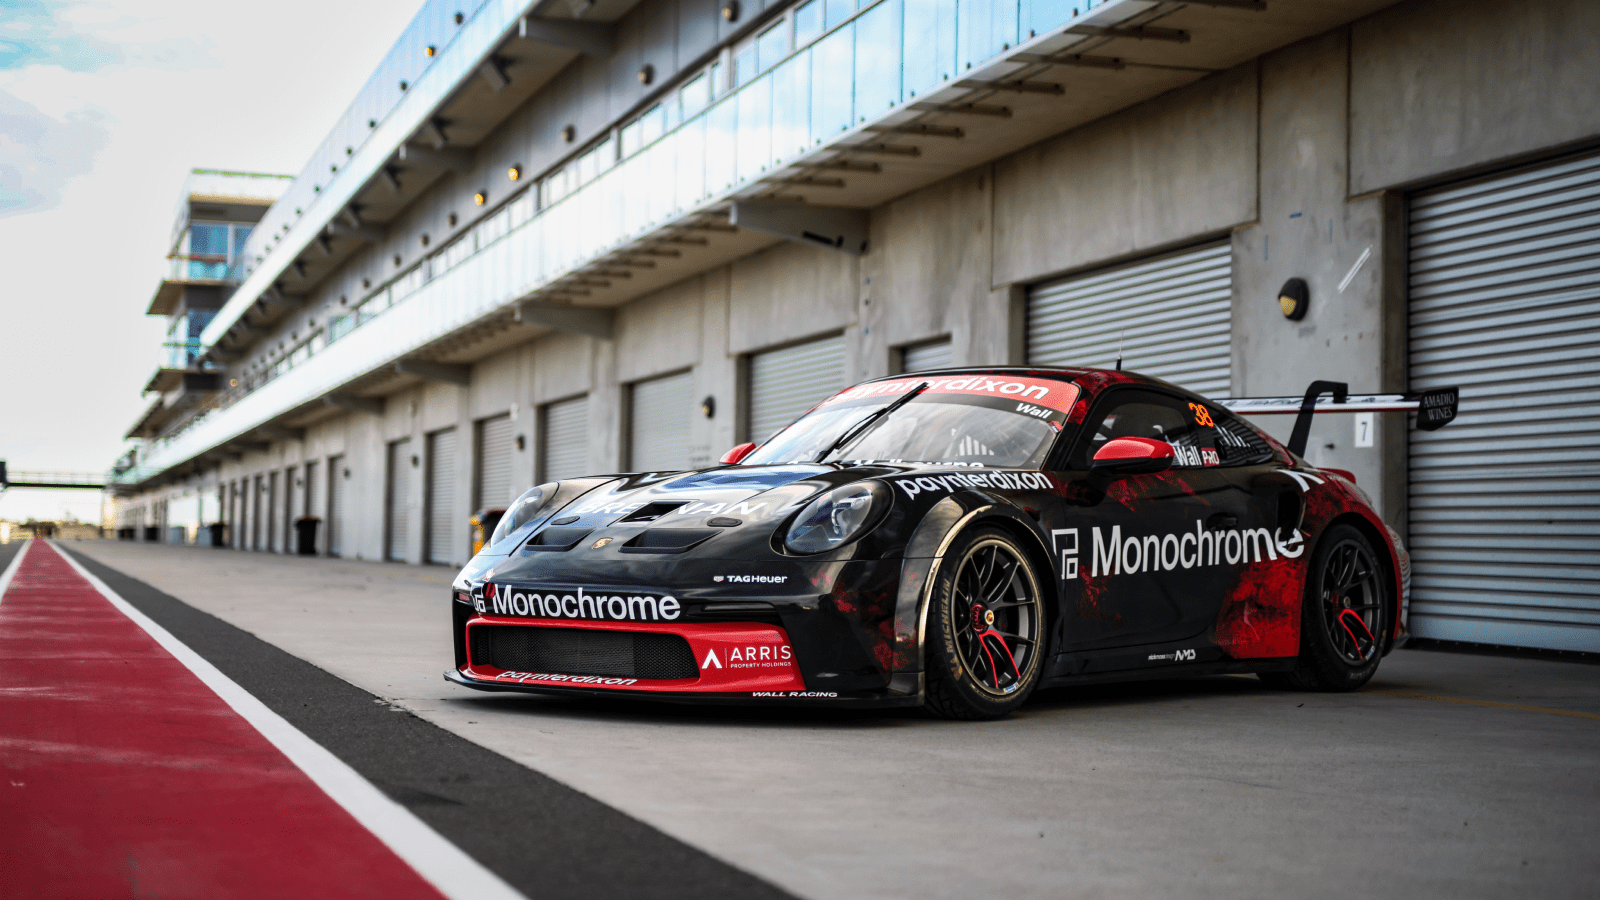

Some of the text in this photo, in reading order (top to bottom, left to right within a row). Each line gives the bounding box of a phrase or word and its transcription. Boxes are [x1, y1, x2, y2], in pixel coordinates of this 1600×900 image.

[1424, 392, 1455, 408] AMADIO
[1016, 402, 1053, 419] Wall
[1188, 402, 1214, 427] 38
[1428, 406, 1453, 421] WINES
[1361, 421, 1368, 442] 7
[1173, 446, 1202, 466] Wall
[895, 470, 1054, 500] paynterdixon
[1091, 519, 1305, 578] Monochrome
[493, 583, 681, 620] Monochrome
[939, 578, 951, 653] MICHELIN
[730, 645, 792, 661] ARRIS
[495, 670, 638, 685] paynterdixon
